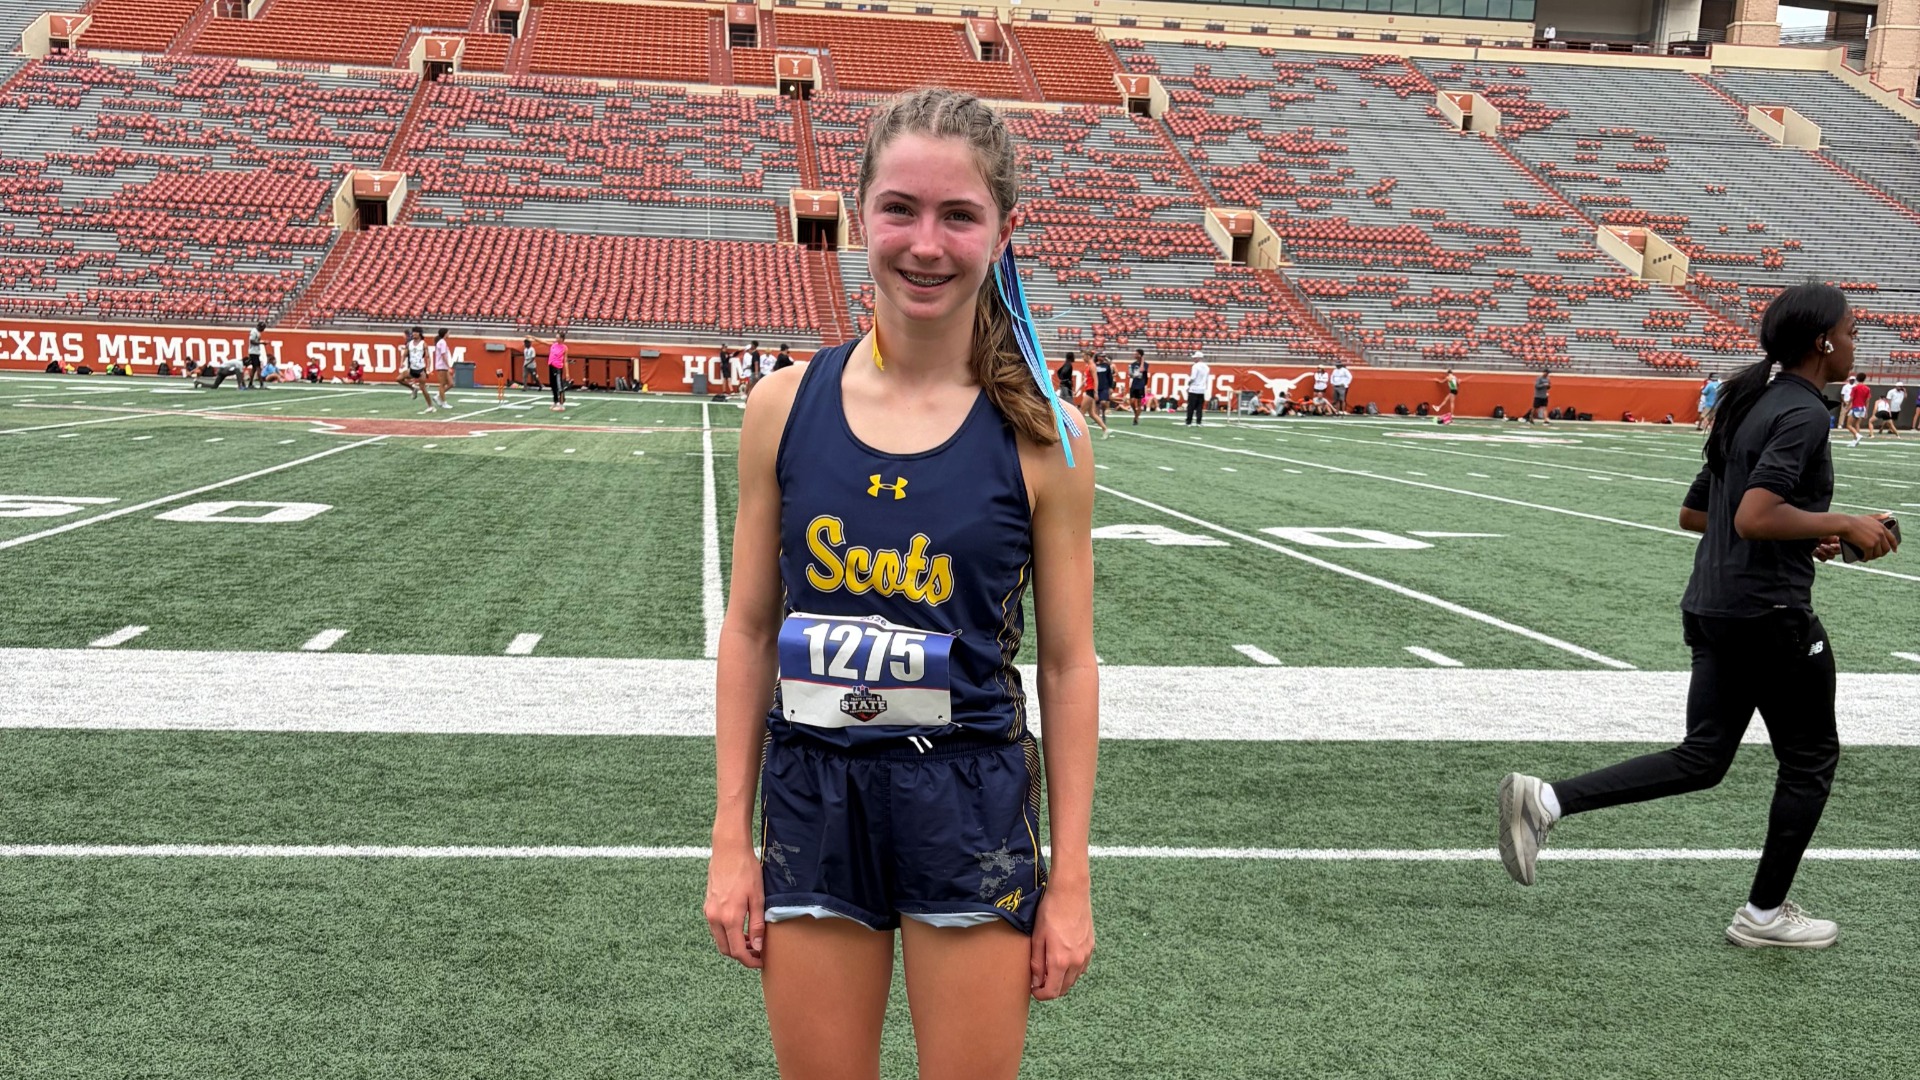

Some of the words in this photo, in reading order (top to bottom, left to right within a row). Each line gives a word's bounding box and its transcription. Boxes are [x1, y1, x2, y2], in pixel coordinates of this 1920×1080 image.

[806, 515, 954, 606] Scots
[803, 623, 927, 682] 1275
[841, 700, 887, 711] STATE
